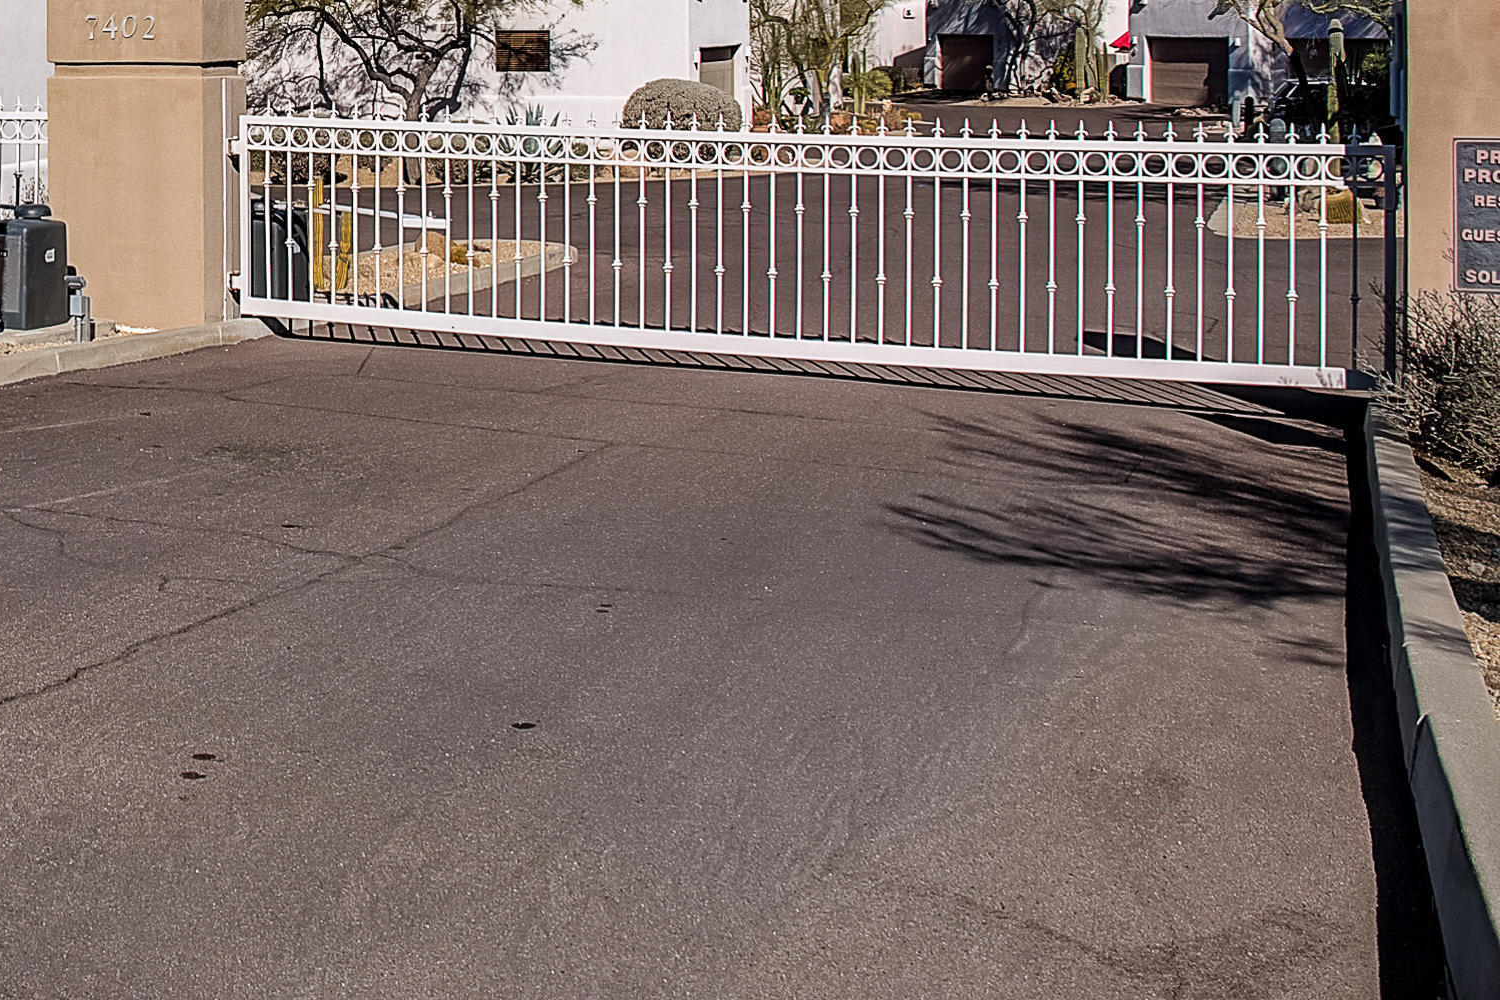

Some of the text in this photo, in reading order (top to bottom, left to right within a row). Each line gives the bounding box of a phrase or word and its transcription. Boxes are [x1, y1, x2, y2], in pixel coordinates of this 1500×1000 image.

[85, 13, 156, 40] 7402
[1474, 194, 1500, 207] RE
[1464, 268, 1500, 284] SOL
